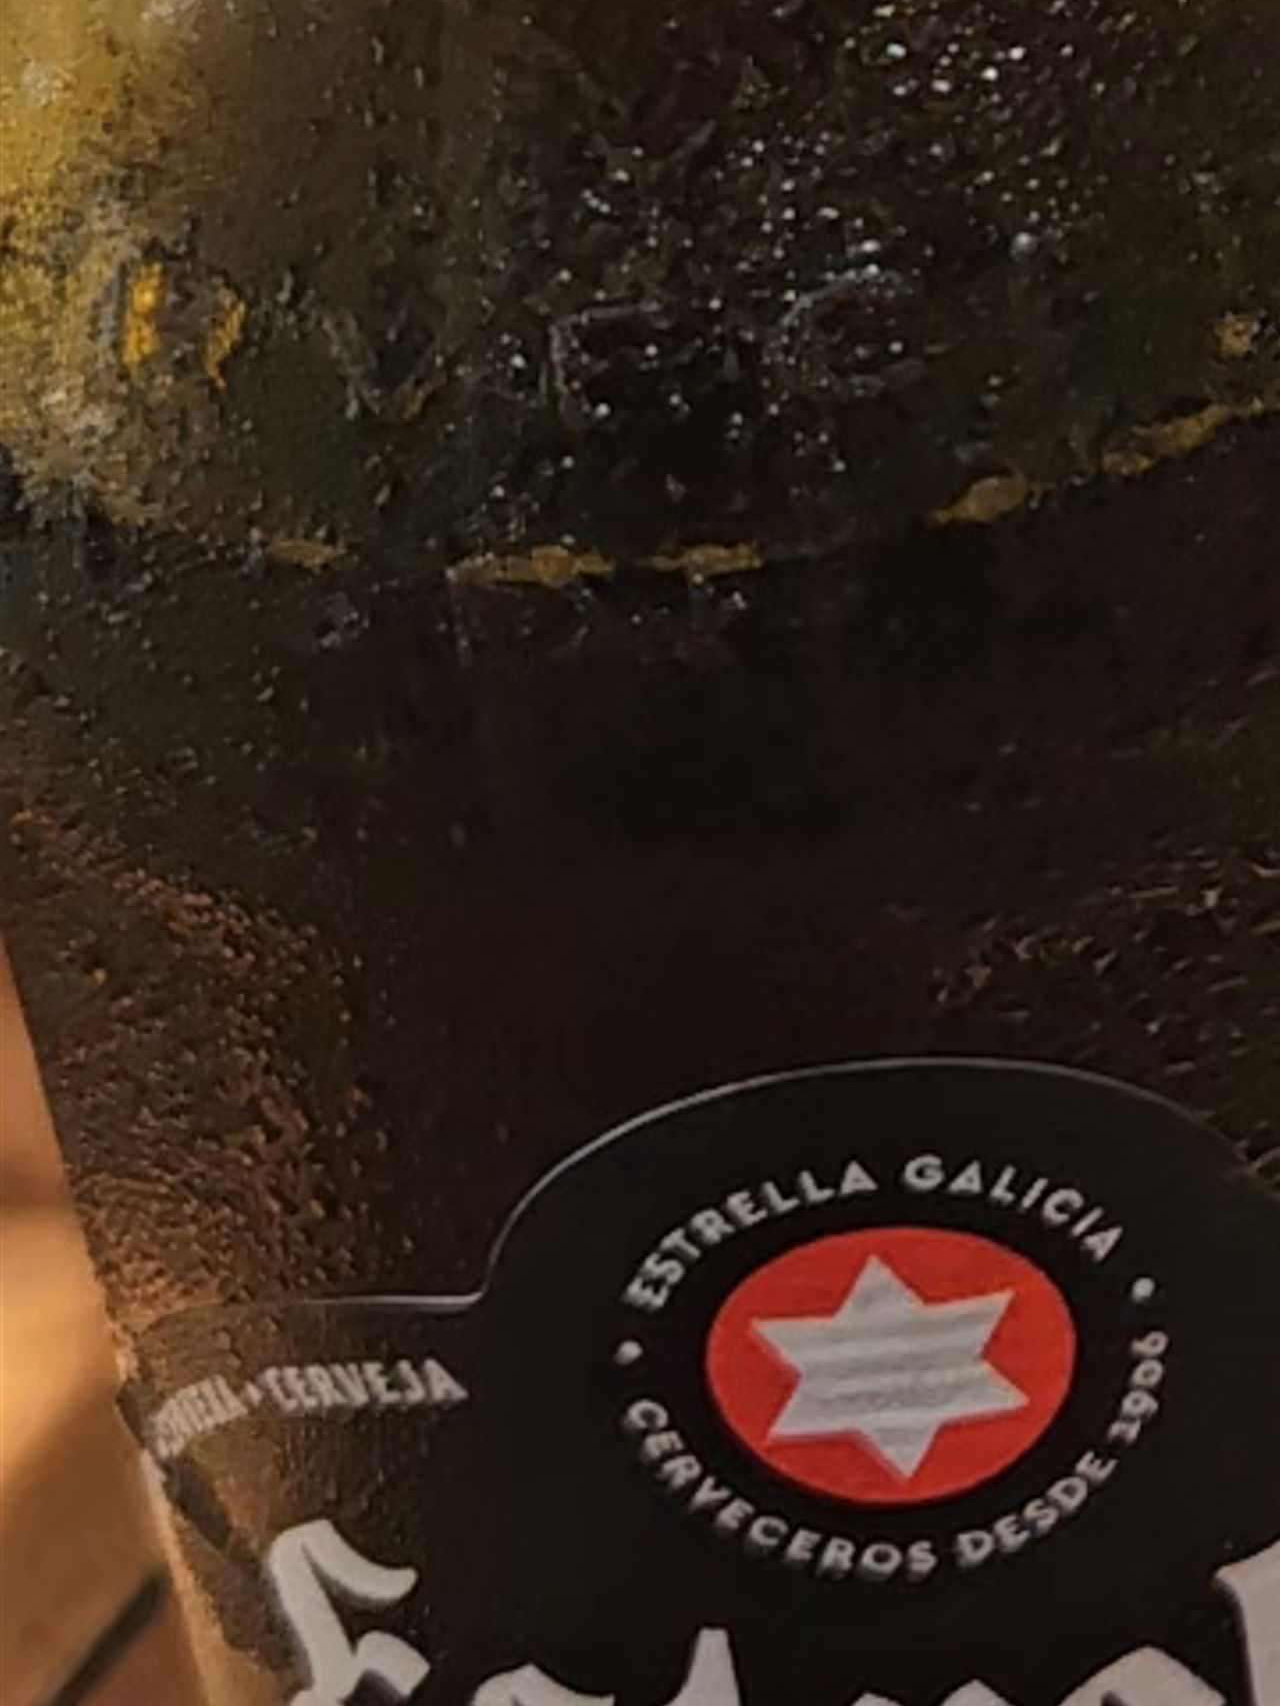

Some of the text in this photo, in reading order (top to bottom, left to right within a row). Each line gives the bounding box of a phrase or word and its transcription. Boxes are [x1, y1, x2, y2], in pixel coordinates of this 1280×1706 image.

[624, 1153, 1124, 1310] ESTRELLA GALICIA
[258, 1358, 468, 1412] CERVEJA
[622, 1329, 1169, 1576] CERVECEROS DESDE 1906
